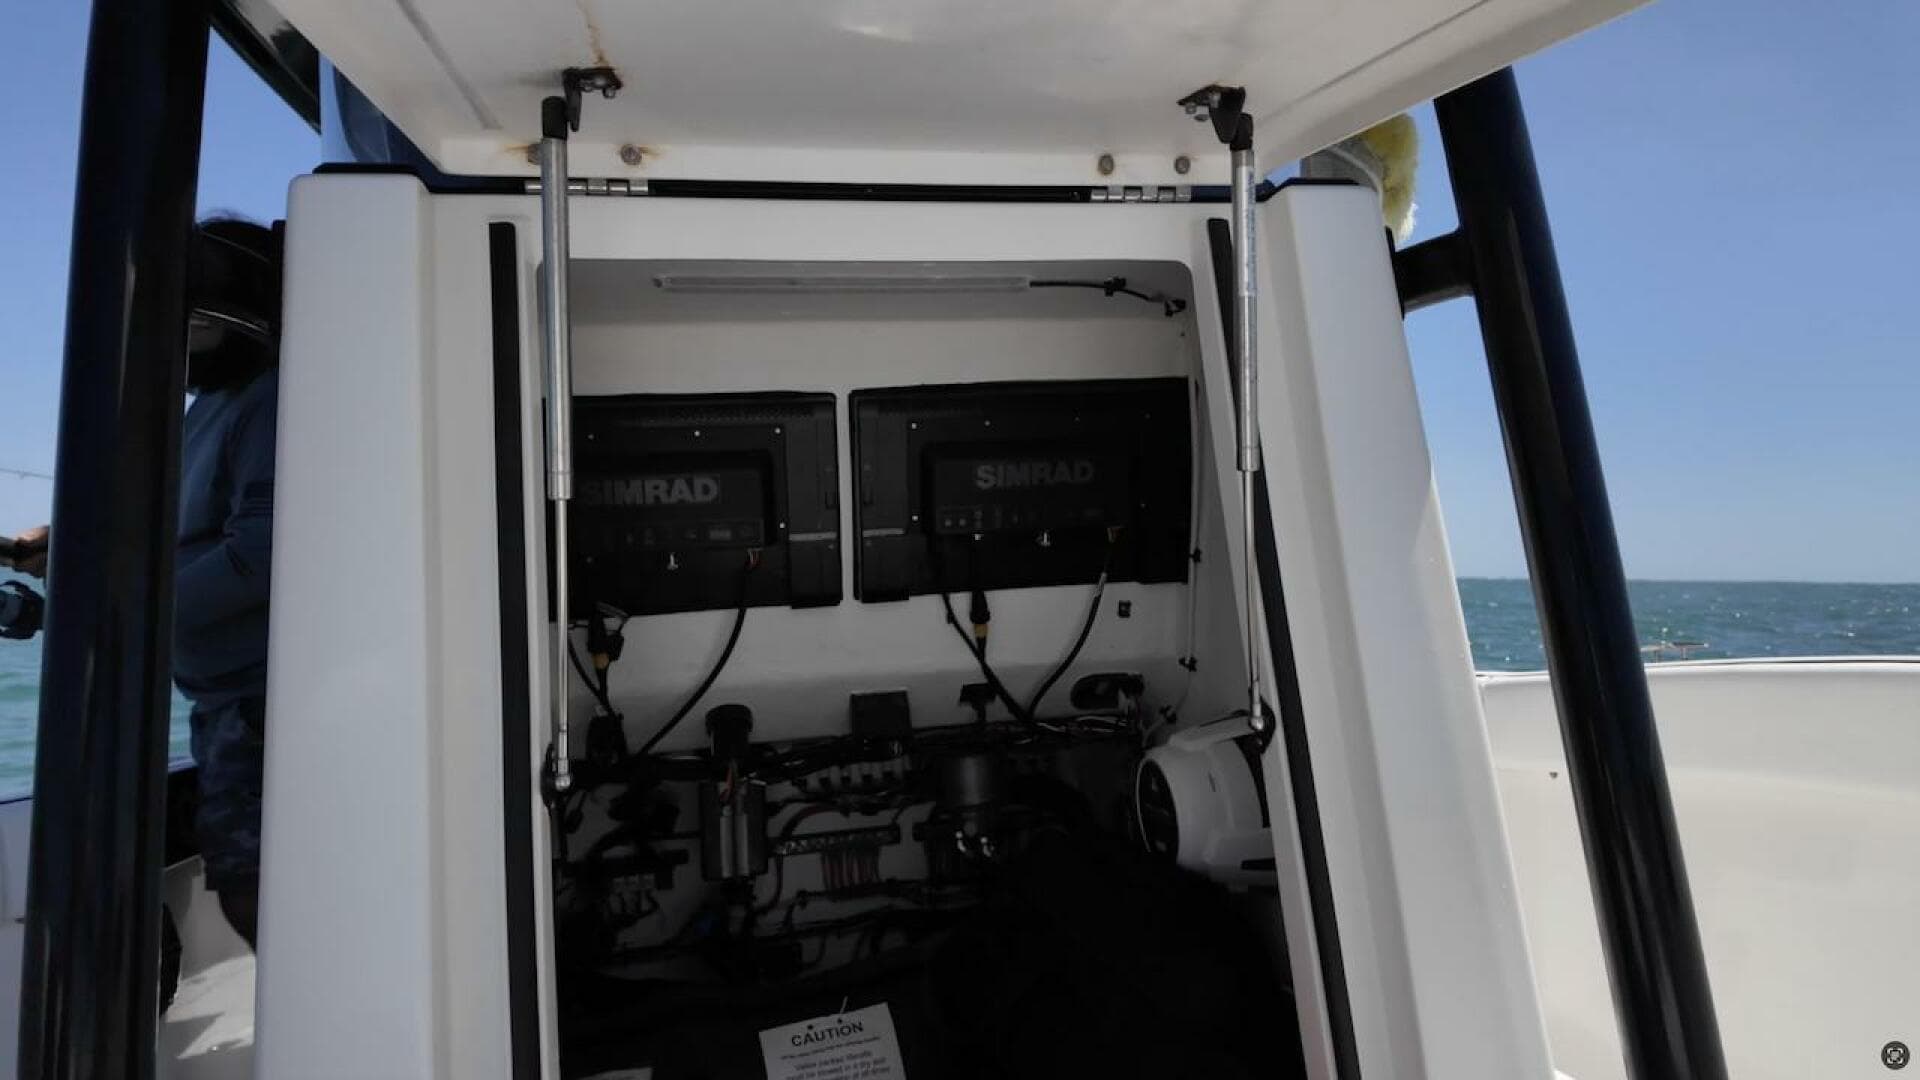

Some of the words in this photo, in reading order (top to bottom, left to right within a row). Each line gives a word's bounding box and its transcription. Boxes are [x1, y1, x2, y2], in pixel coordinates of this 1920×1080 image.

[578, 475, 719, 505] SIMRAD
[976, 460, 1095, 490] SIMRAD
[791, 1021, 864, 1047] CAUTION
